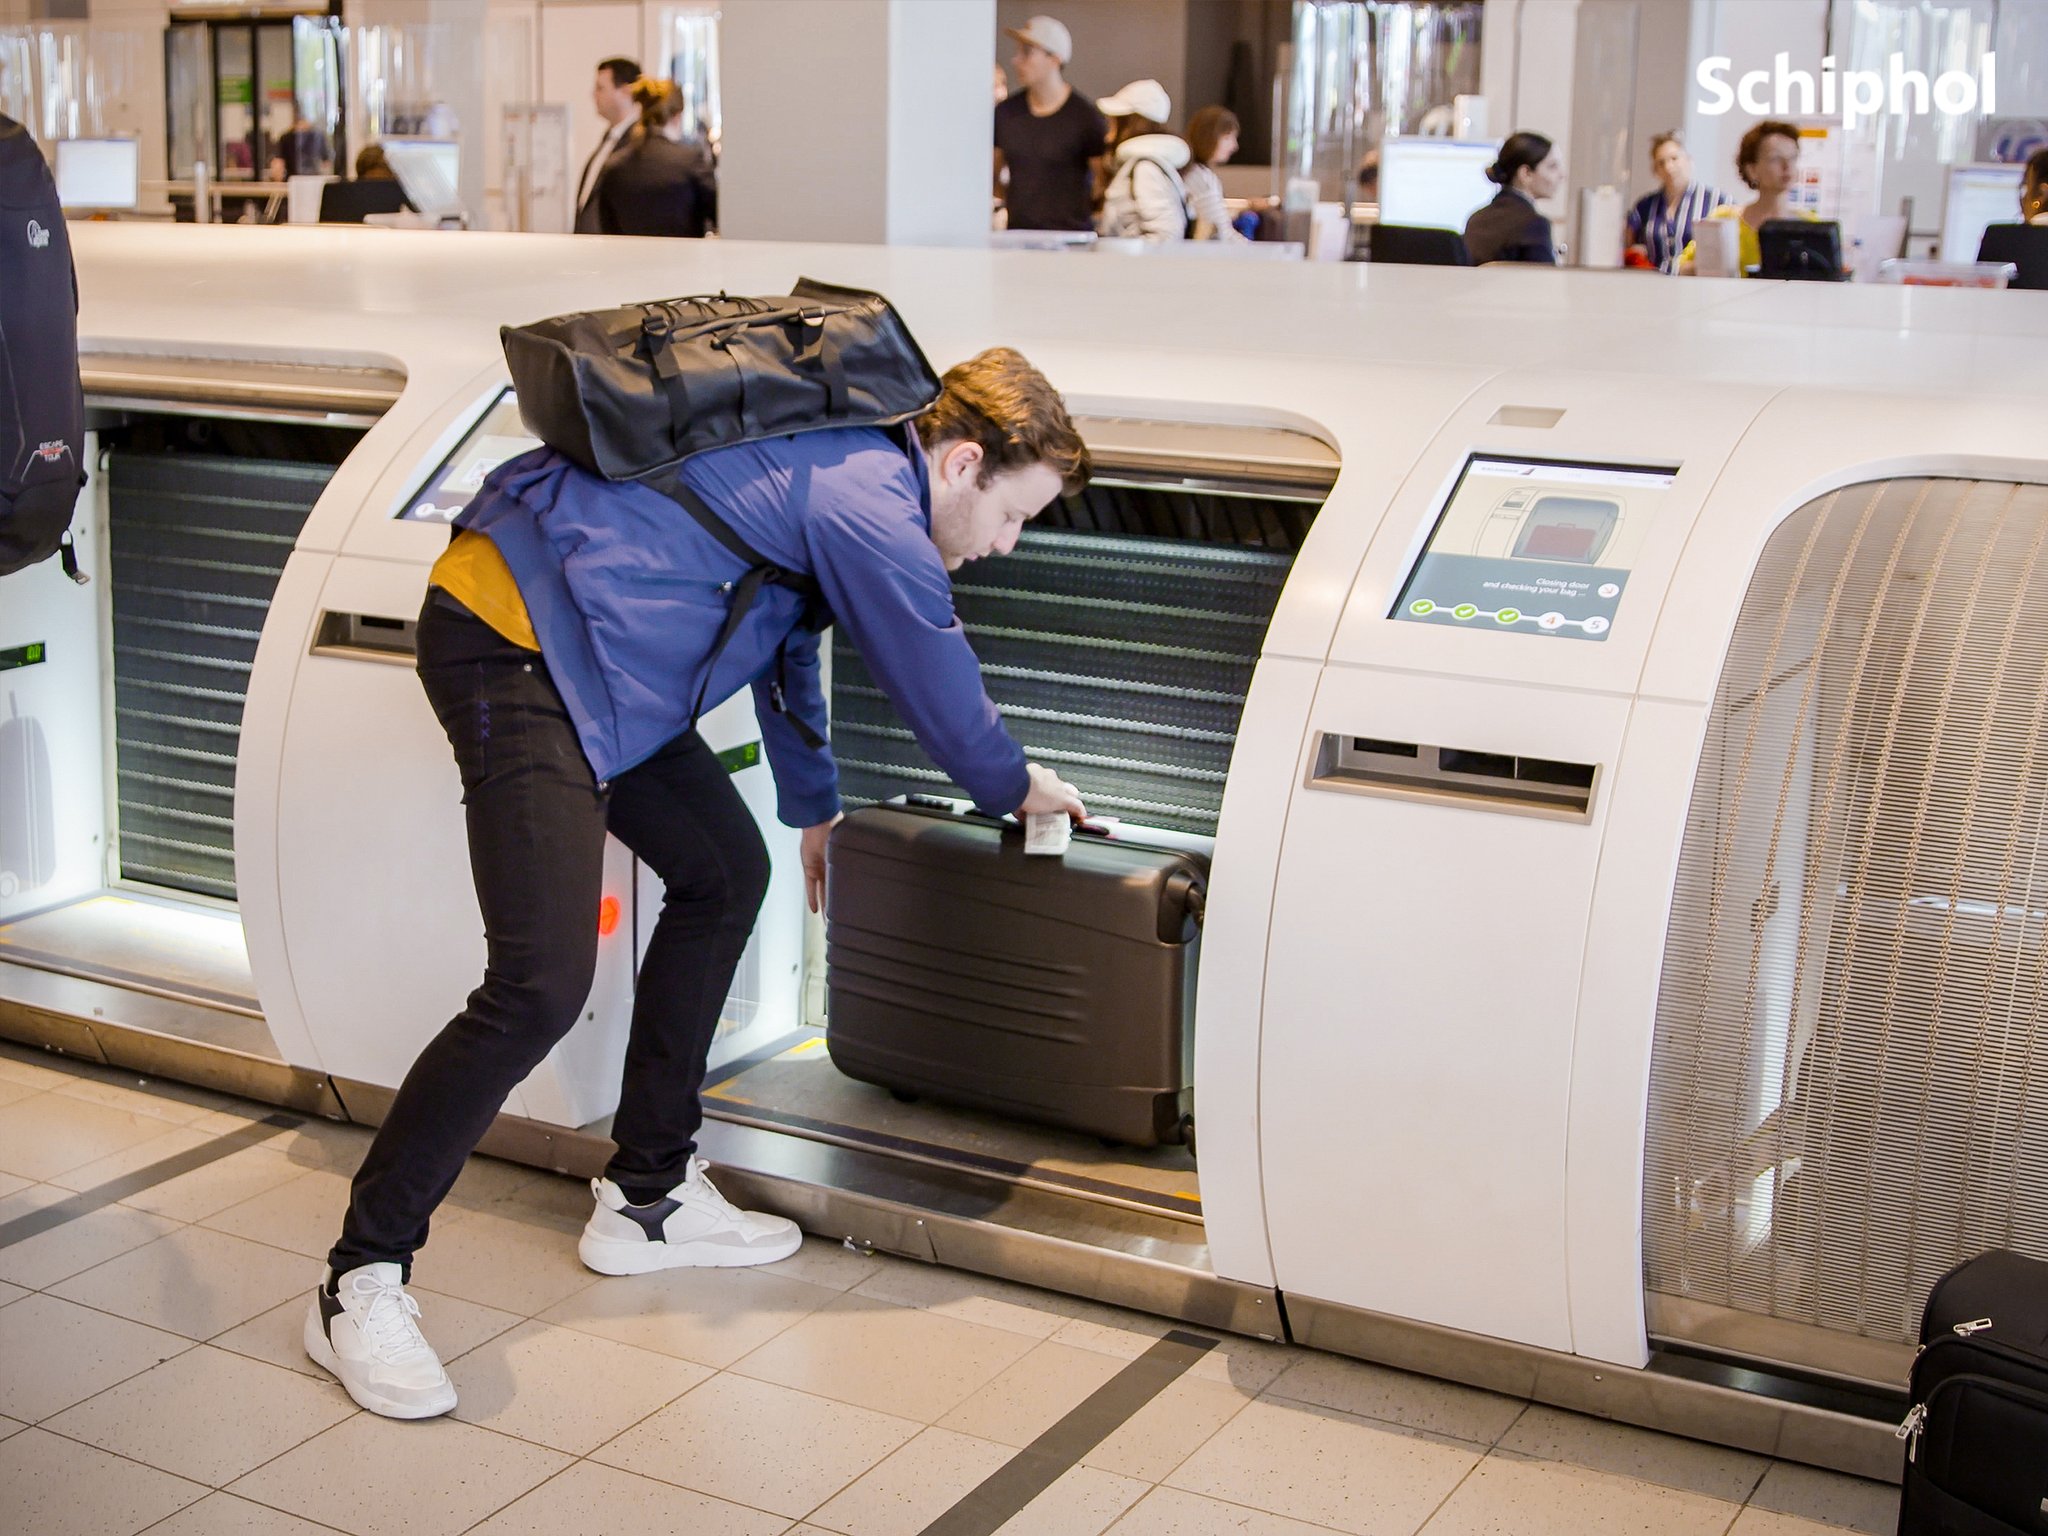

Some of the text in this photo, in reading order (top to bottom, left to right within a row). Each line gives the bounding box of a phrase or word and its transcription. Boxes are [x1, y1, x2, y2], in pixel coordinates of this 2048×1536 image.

[1500, 582, 1538, 594] checking
[1538, 586, 1560, 594] your
[1559, 588, 1577, 597] bag
[1536, 577, 1590, 589] Closing door
[1546, 616, 1601, 629] 4 5
